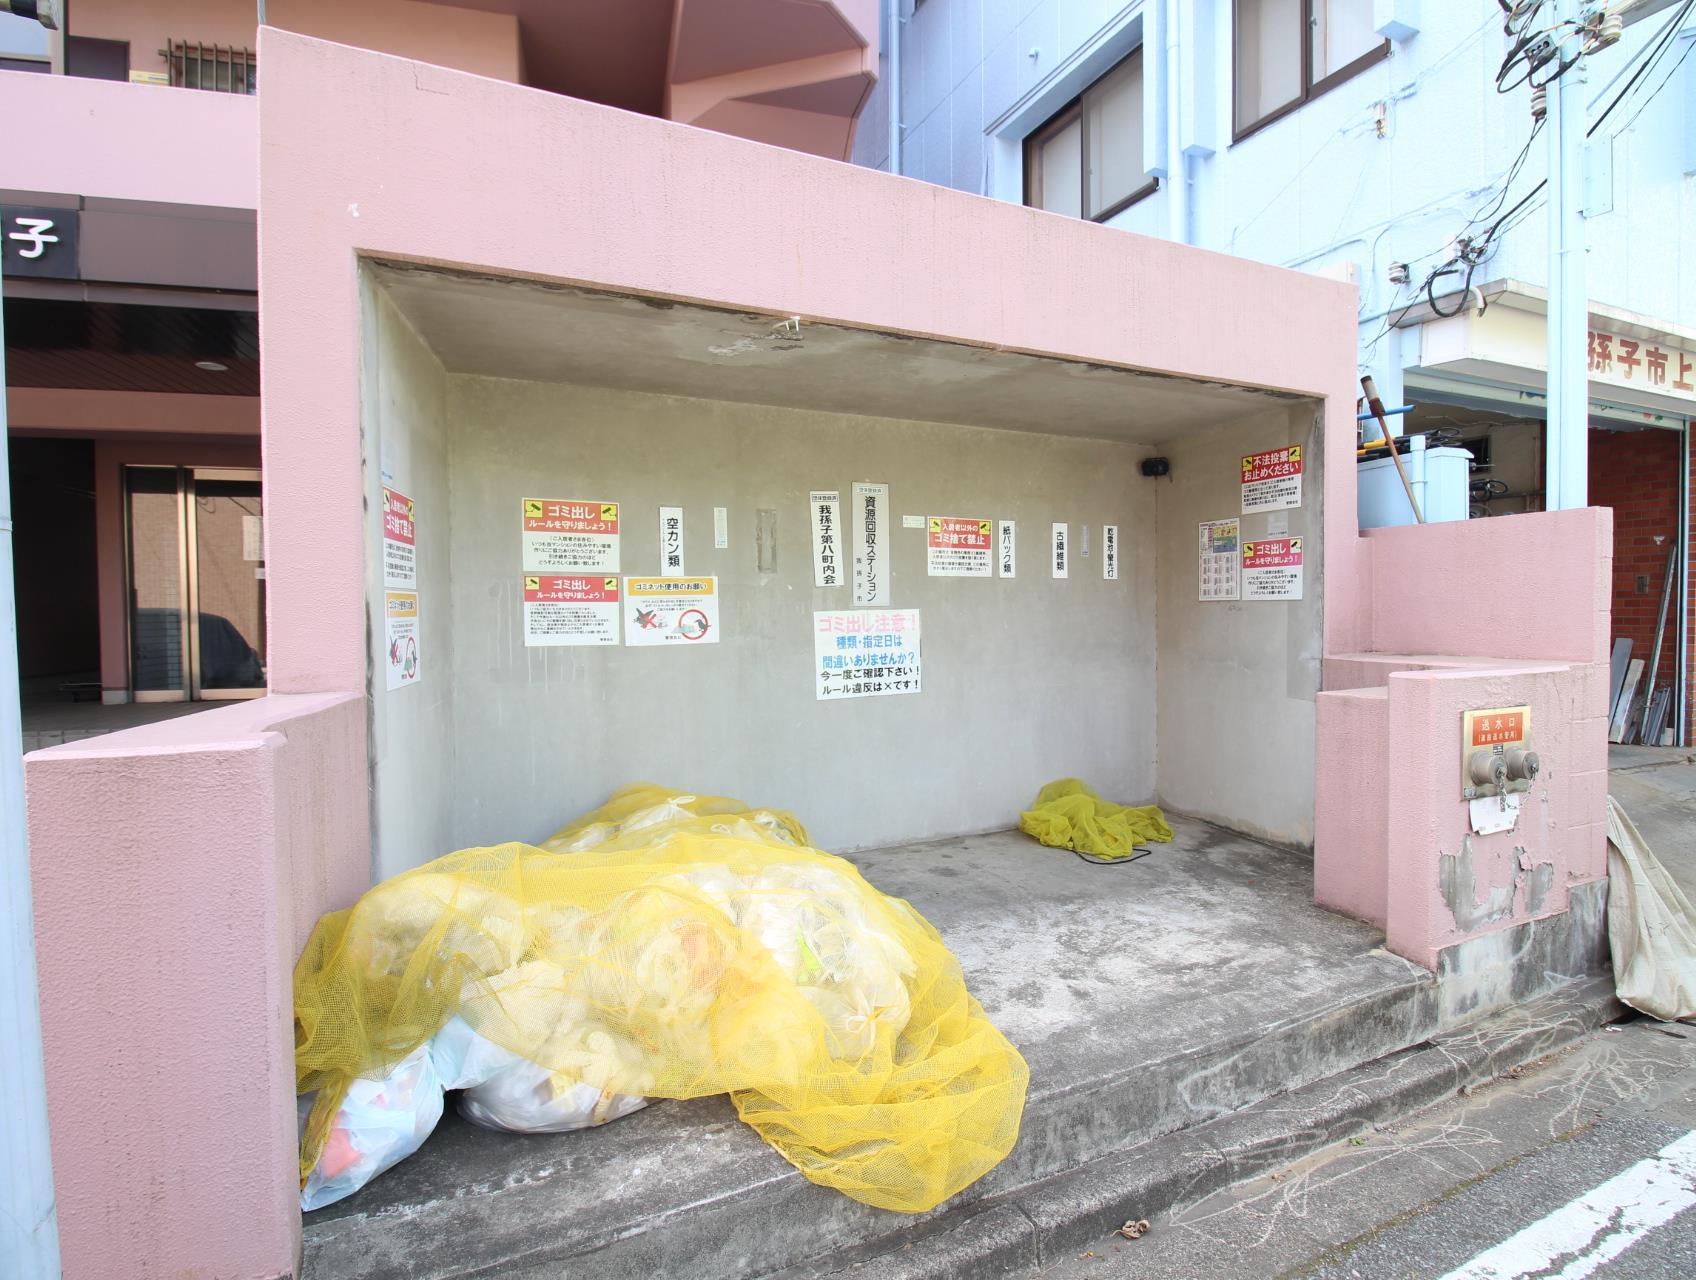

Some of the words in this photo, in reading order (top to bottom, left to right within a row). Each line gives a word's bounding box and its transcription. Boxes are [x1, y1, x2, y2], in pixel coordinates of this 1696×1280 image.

[1253, 450, 1289, 467] 不法投棄
[1244, 462, 1299, 481] お止めください
[548, 505, 595, 519] ゴミ出し
[667, 517, 680, 567] 空カン類
[818, 505, 836, 584] 我孫子第八町内会
[934, 533, 985, 545] ゴミ捨て禁止
[865, 496, 876, 602] 資源回収ステーション
[1003, 526, 1011, 573] 紙パック類
[1257, 543, 1287, 555] ゴミ出し
[553, 579, 591, 590] ゴミ出し
[836, 634, 902, 649] 種類・指定日は
[1481, 718, 1515, 731] 送水口
